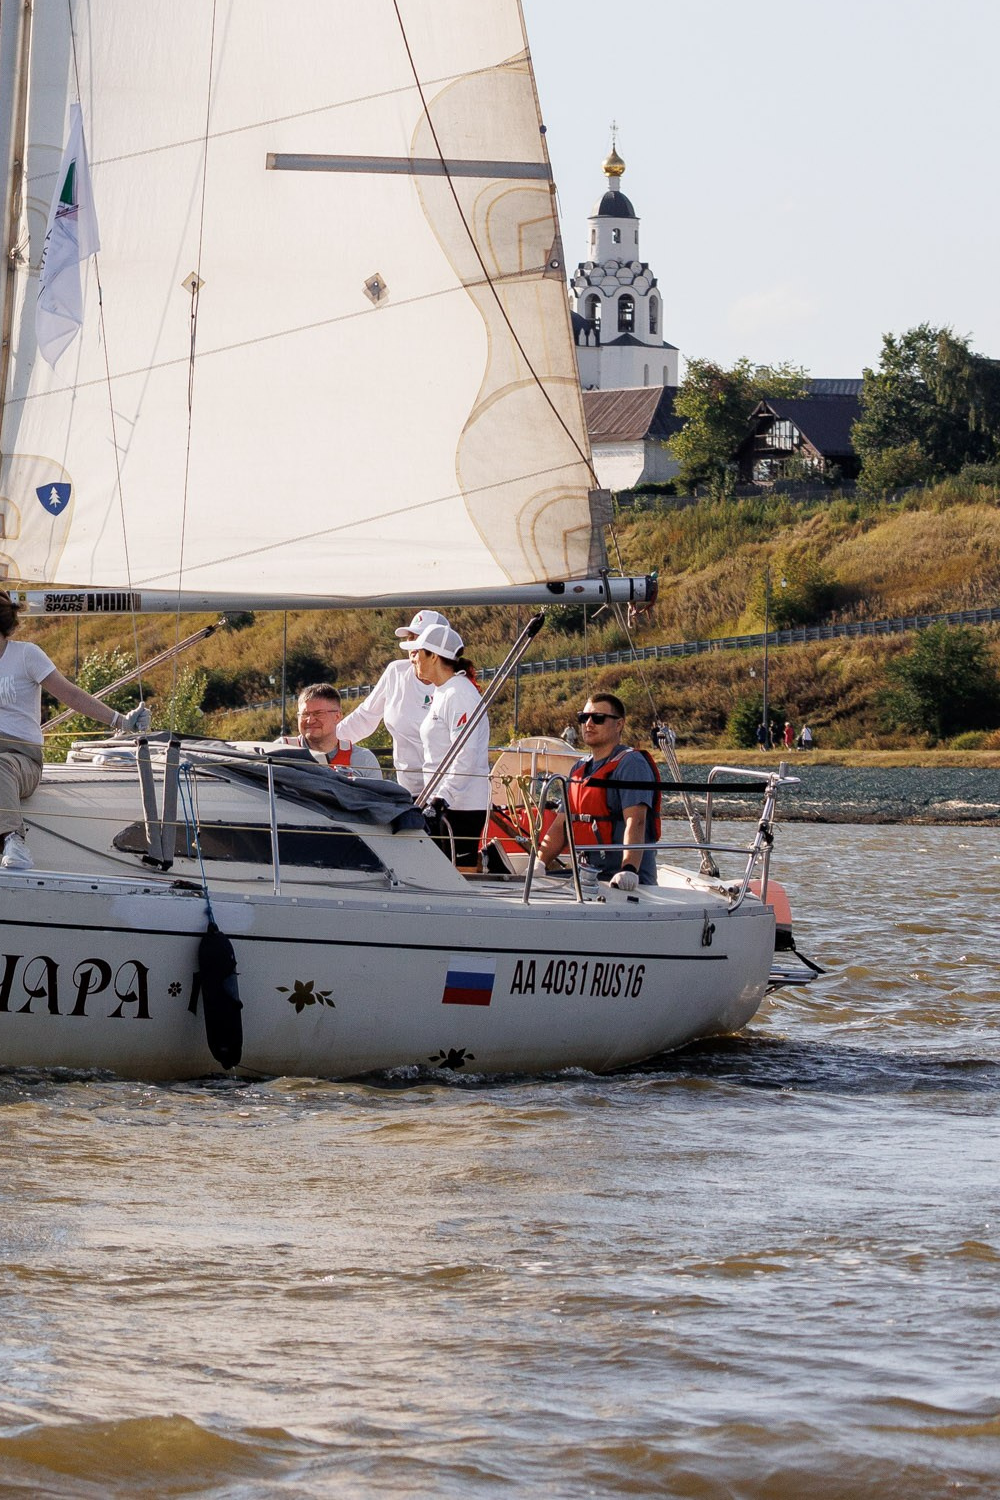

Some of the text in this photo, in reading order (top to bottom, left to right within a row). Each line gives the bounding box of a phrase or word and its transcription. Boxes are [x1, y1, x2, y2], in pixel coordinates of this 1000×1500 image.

[45, 594, 85, 603] SWEDE
[45, 603, 83, 612] SPARS
[541, 960, 588, 995] 4031
